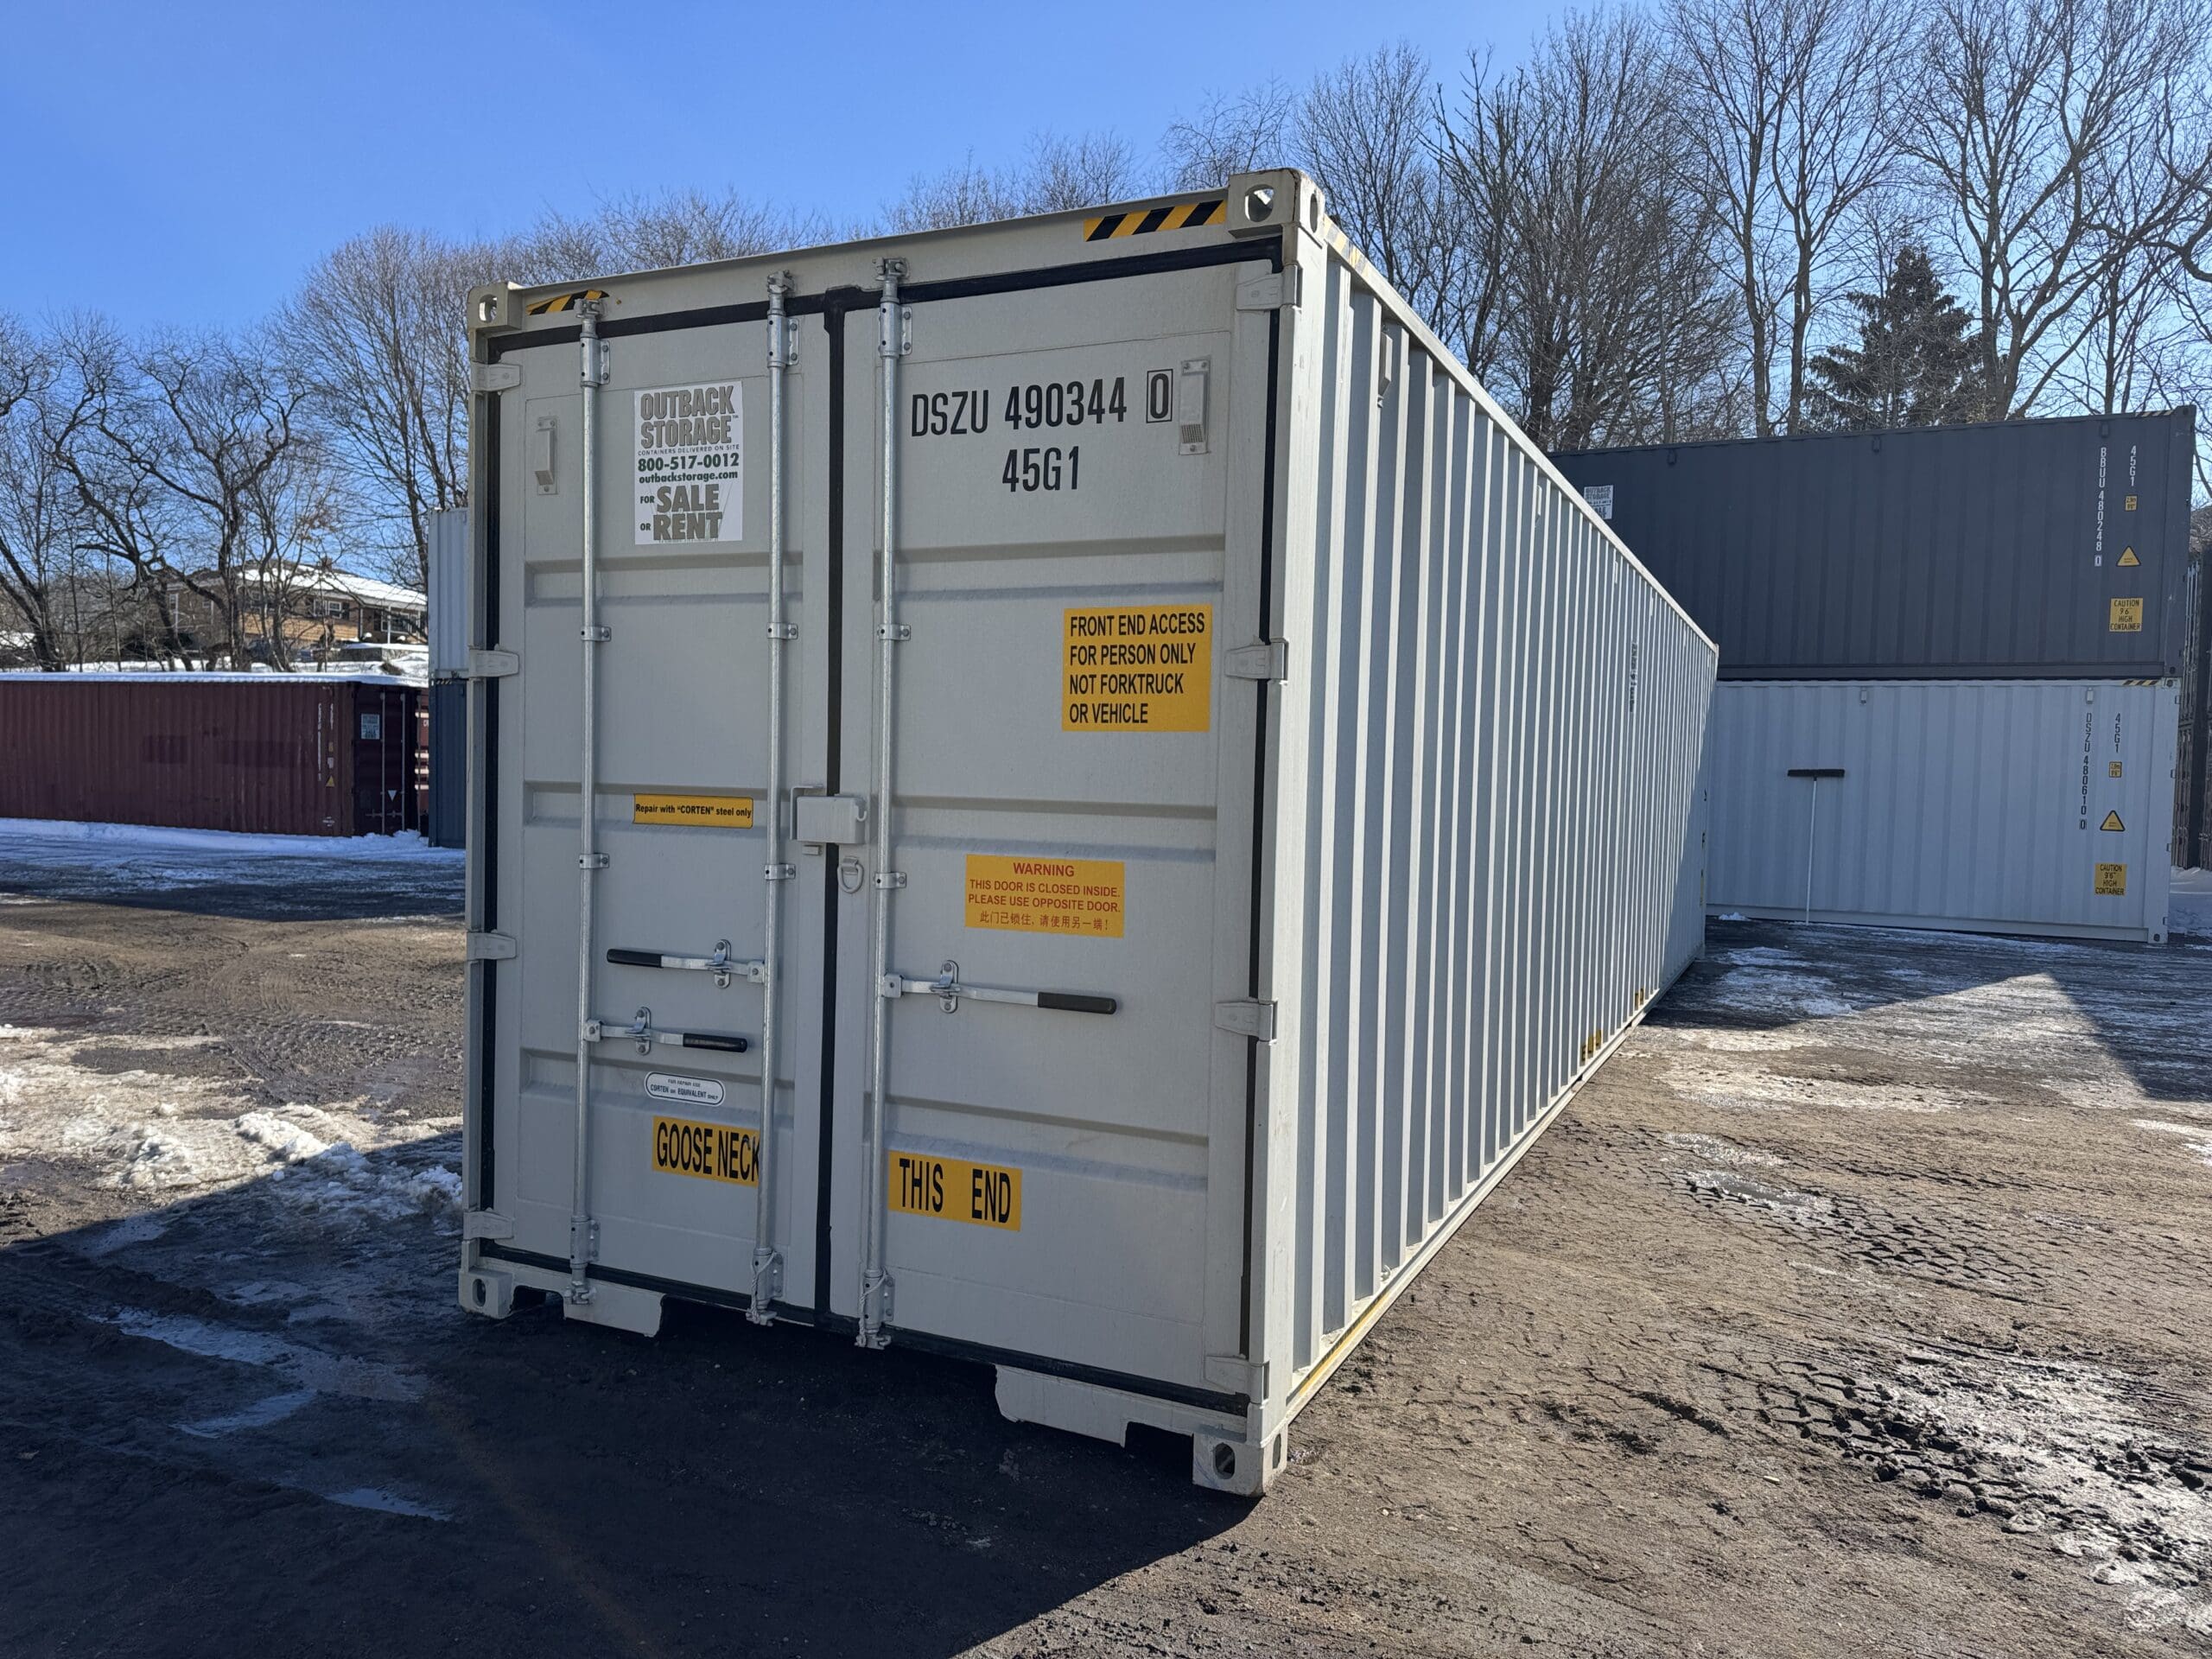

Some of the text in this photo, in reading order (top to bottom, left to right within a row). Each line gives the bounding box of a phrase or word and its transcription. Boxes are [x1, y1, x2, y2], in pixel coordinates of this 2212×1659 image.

[640, 385, 735, 421] OUTBACK
[912, 373, 1169, 436] DSZU 490344 0
[640, 415, 732, 449] STORAGE
[638, 452, 740, 472] 800-517-0012
[1001, 446, 1079, 493] 45G1
[639, 471, 738, 484] outbackstorage.com
[640, 484, 720, 513] FOR SALE
[653, 512, 723, 541] RENT
[2095, 490, 2104, 551] 480248
[1071, 613, 1205, 637] FRONT END ACCESS
[1070, 643, 1196, 665] FOR PERSON ONLY
[1070, 673, 1184, 695] NOT FORKTRUCK
[1070, 703, 1148, 723] OR VEHICLE
[635, 804, 658, 814] Repair
[660, 804, 675, 813] with
[716, 807, 734, 816] steel
[736, 808, 752, 818] only
[1013, 862, 1075, 877] WARNING
[969, 879, 1121, 898] THIS DOOR IS CLOSED INSIDE.
[2095, 887, 2125, 895] CONTAINER
[968, 893, 1121, 912] PLEASE USE OPPOSITE DOOR.
[677, 1088, 707, 1098] EQUIVALENT
[656, 1122, 760, 1183] GOOSE NECK
[899, 1158, 1012, 1224] THIS END
